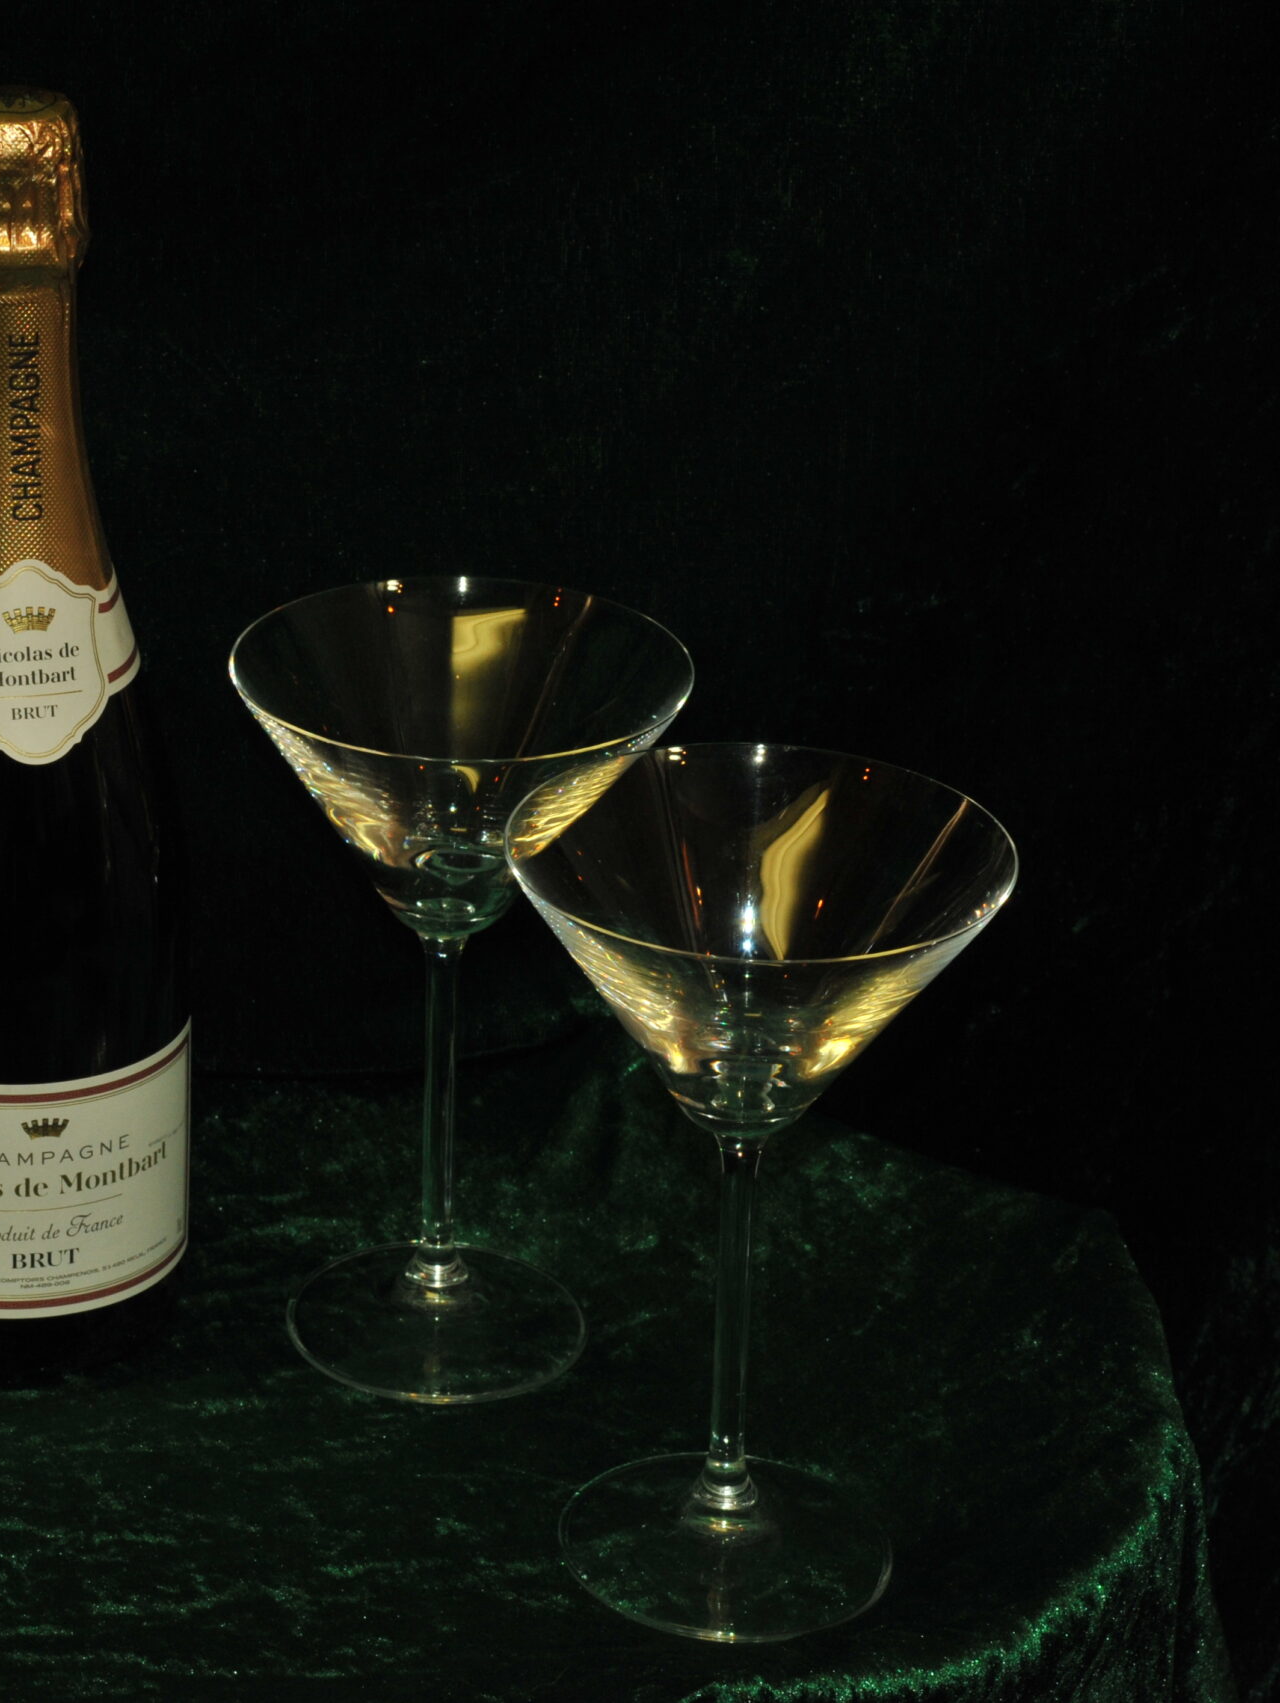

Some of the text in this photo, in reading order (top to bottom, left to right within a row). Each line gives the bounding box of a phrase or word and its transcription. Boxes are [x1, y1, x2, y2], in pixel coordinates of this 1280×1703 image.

[8, 332, 43, 521] CHAMPAGNE
[59, 642, 80, 659] de
[11, 704, 58, 721] BRUT
[14, 1177, 49, 1198] de
[59, 1140, 167, 1195] Montbart
[41, 1223, 61, 1241] de
[65, 1212, 124, 1238] France
[11, 1247, 80, 1270] BRUT
